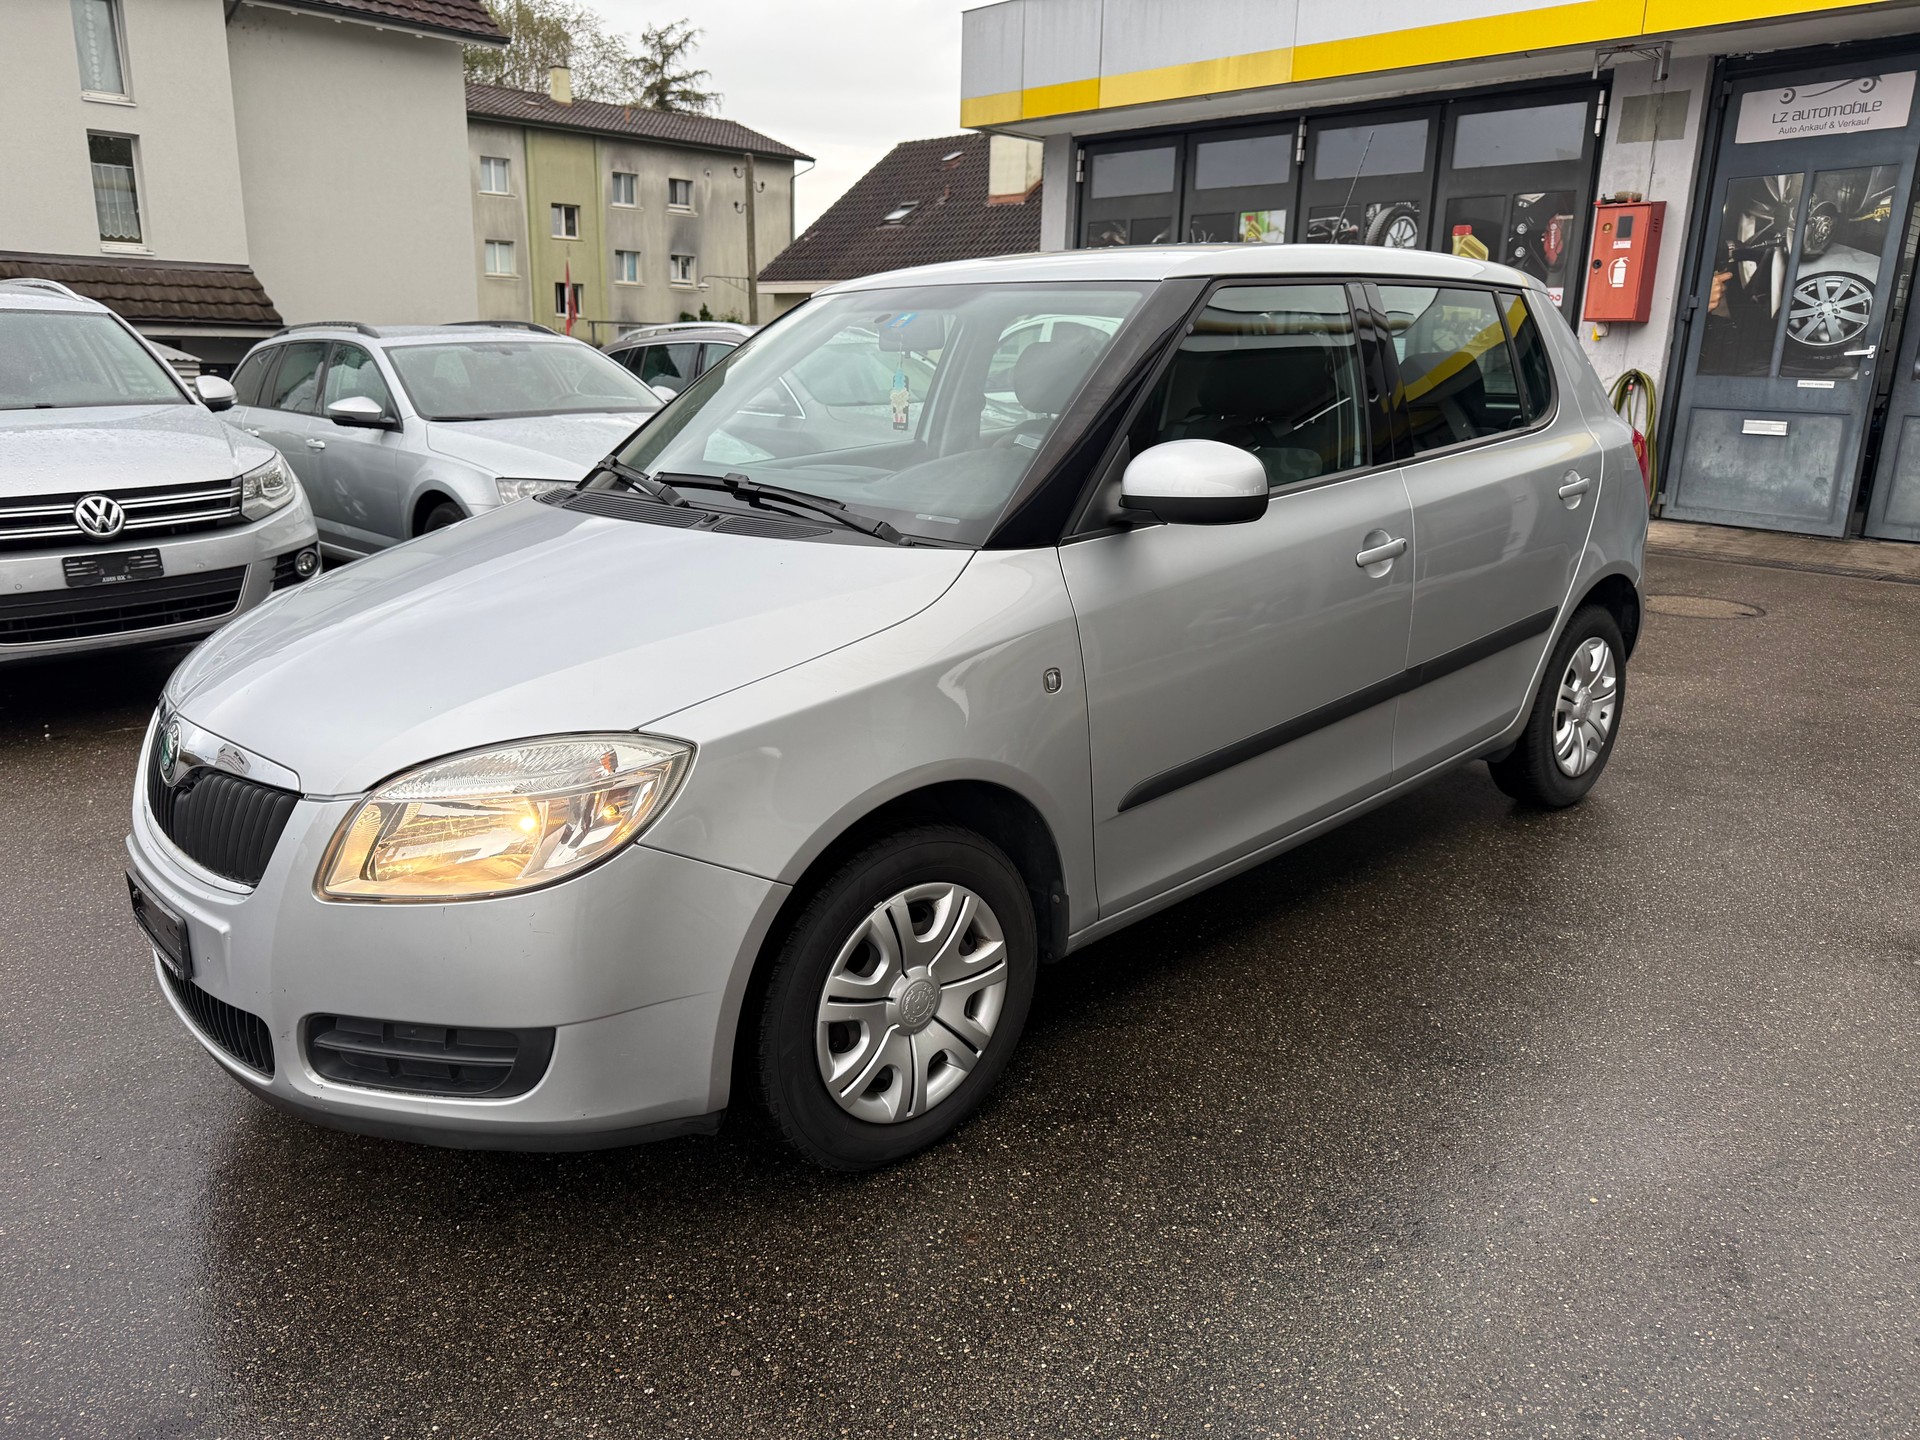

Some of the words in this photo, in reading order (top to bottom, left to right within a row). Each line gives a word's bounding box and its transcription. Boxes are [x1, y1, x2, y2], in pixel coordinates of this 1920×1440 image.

[1772, 111, 1789, 124] LZ
[1778, 126, 1797, 135] Auto
[1798, 121, 1828, 133] Ankauf
[1828, 121, 1835, 129] &
[1838, 116, 1871, 128] Verkauf
[78, 496, 122, 535] VW
